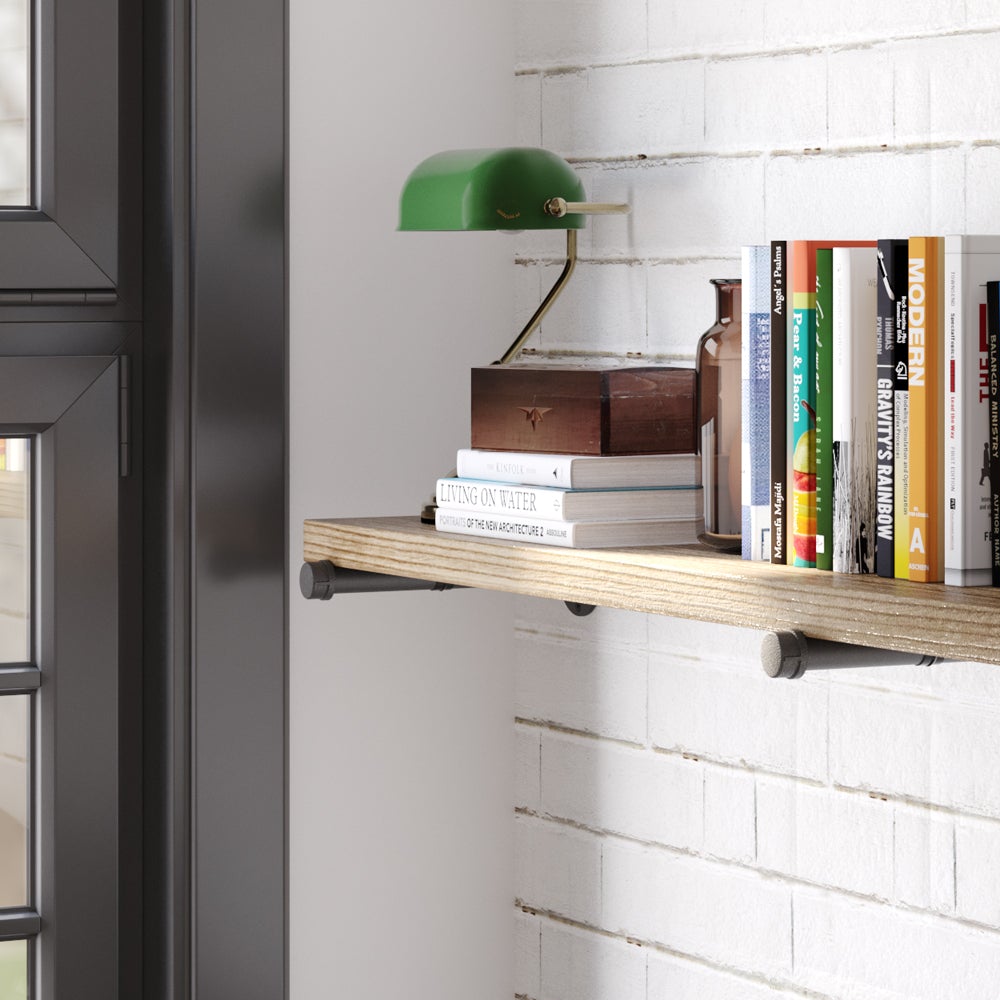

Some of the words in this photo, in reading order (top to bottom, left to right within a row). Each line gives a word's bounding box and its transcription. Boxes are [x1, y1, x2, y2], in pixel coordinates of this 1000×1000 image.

[774, 246, 782, 278] Psalms
[793, 312, 802, 351] Pear
[885, 318, 894, 351] THOMAS
[909, 258, 925, 387] MODERN
[794, 356, 802, 369] &
[793, 374, 802, 423] Bacon
[496, 462, 524, 475] KINFOLK
[440, 484, 477, 505] LIVING
[481, 488, 497, 507] ON
[500, 490, 537, 511] WATER
[774, 482, 785, 515] Majidi
[878, 464, 893, 540] RAINBOW
[467, 518, 474, 529] OF
[475, 520, 485, 530] THE
[486, 521, 499, 531] NEW
[499, 522, 539, 536] ARCHITECTURE
[540, 526, 544, 537] 2
[774, 518, 782, 559] Mostafa
[910, 528, 925, 554] A
